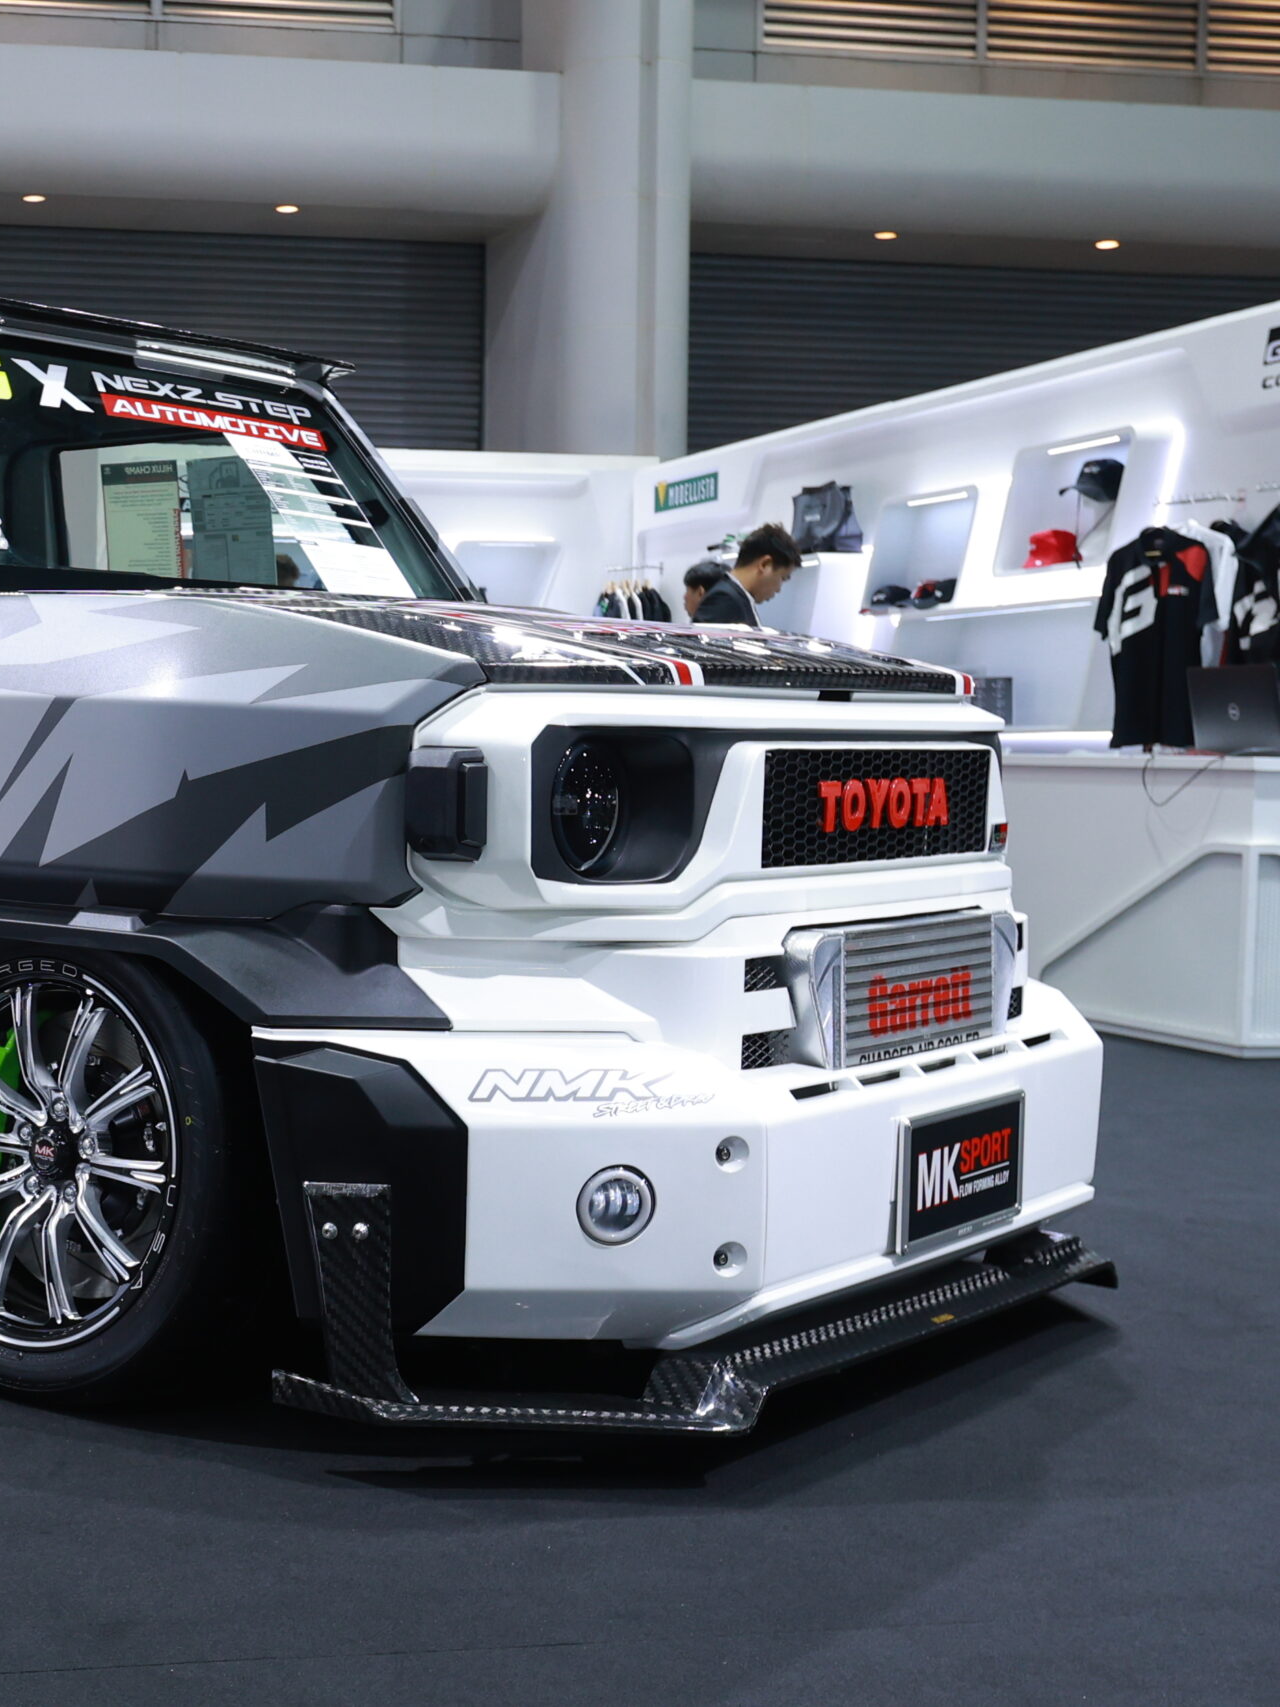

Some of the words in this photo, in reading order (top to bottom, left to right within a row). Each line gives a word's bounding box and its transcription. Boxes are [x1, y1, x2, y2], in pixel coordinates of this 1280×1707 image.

[10, 357, 95, 414] X
[112, 398, 322, 448] AUTOMOTIVE
[668, 477, 715, 507] MODELLISTA
[819, 777, 949, 833] TOYOTA
[867, 965, 972, 1037] Garrett
[468, 1068, 675, 1103] NMK
[916, 1142, 961, 1212] MK
[960, 1128, 1012, 1174] SPORT
[959, 1183, 973, 1198] FLOW
[973, 1175, 995, 1194] FORMING
[995, 1170, 1010, 1187] ALLOY
